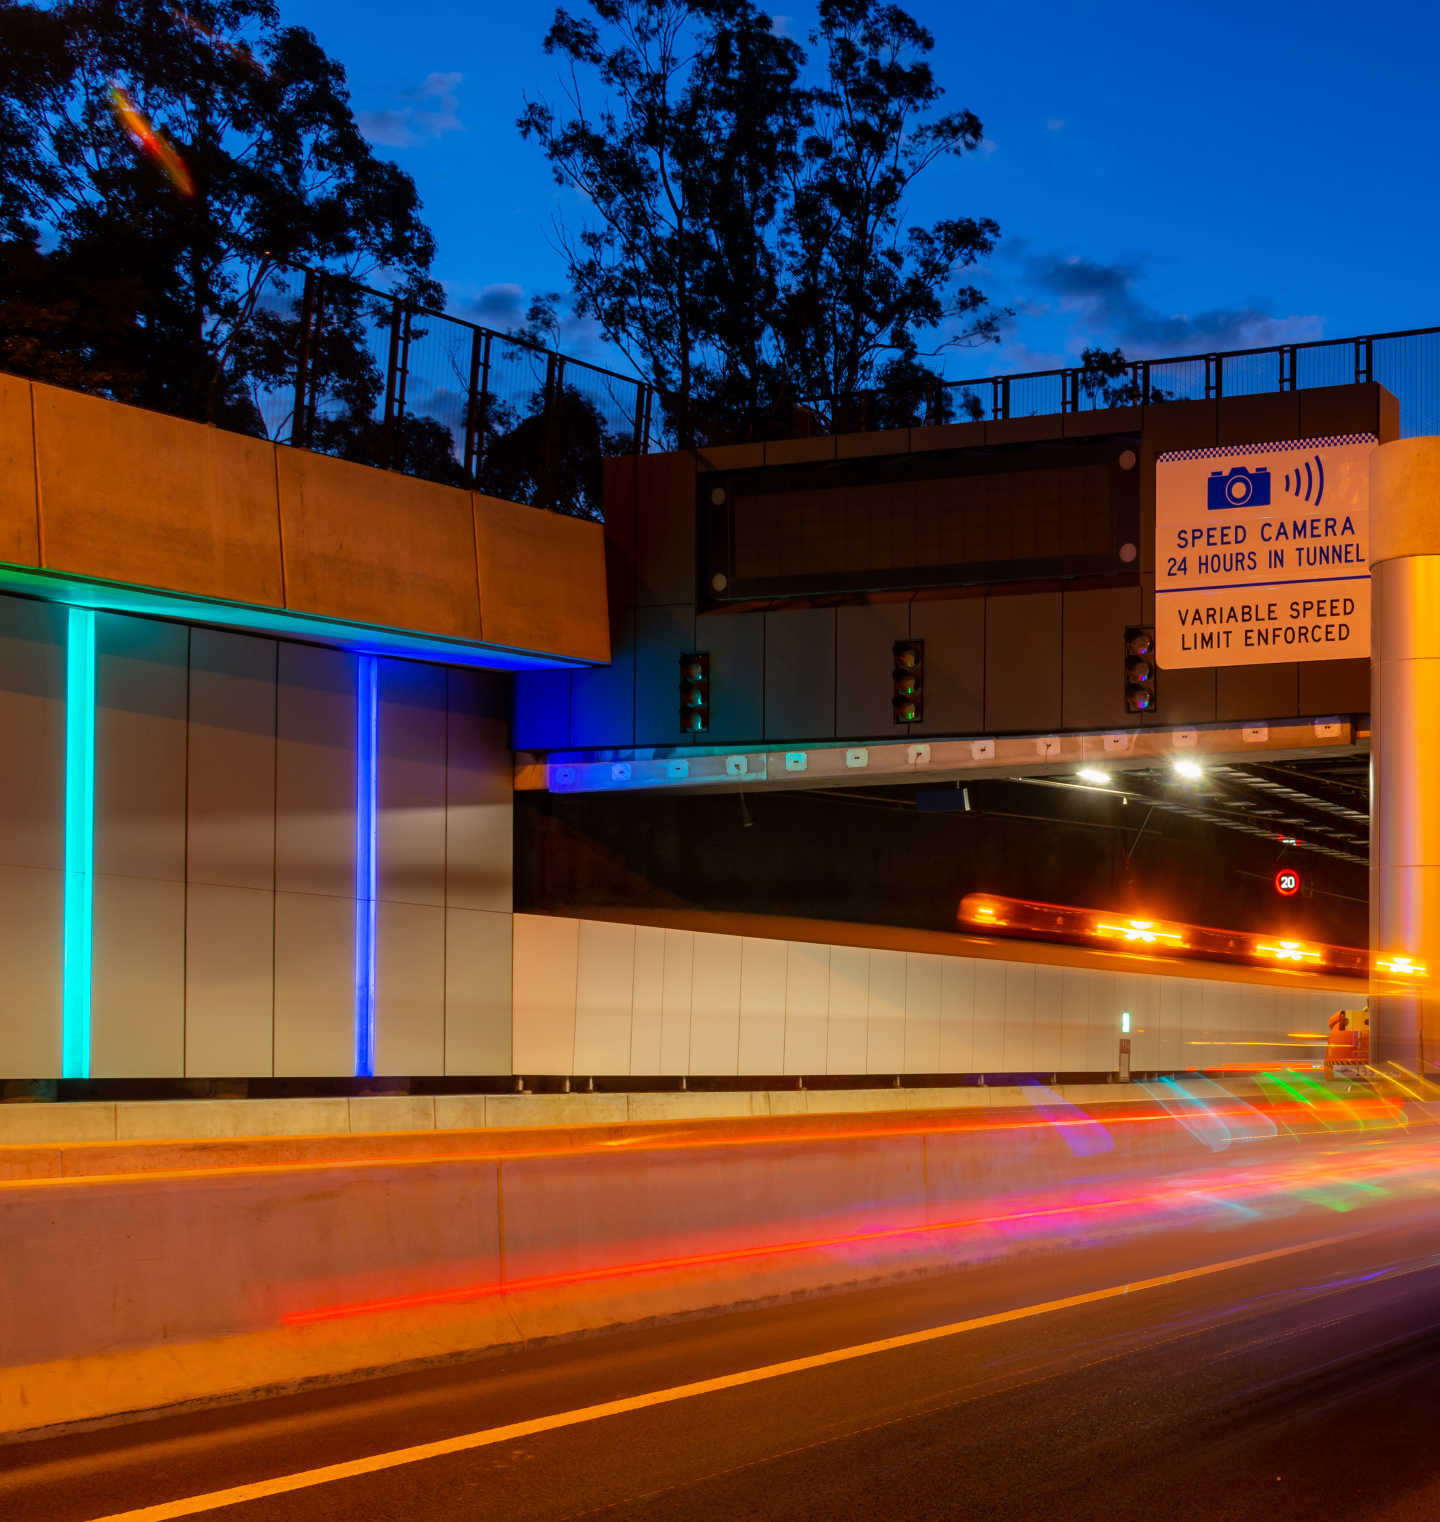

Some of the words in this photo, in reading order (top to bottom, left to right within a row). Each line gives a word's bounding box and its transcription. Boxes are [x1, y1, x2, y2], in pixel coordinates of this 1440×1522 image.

[1177, 525, 1247, 549] SPEED
[1260, 516, 1355, 542] CAMERA
[1167, 557, 1188, 577] 24
[1198, 551, 1257, 574] HOURS
[1268, 549, 1284, 569] IN
[1295, 543, 1366, 567] TUNNEL
[1178, 603, 1278, 626] VARIABLE
[1289, 598, 1355, 619] SPEED
[1181, 631, 1233, 651] LIMIT
[1244, 623, 1350, 647] ENFORCED
[1280, 876, 1296, 889] 20
